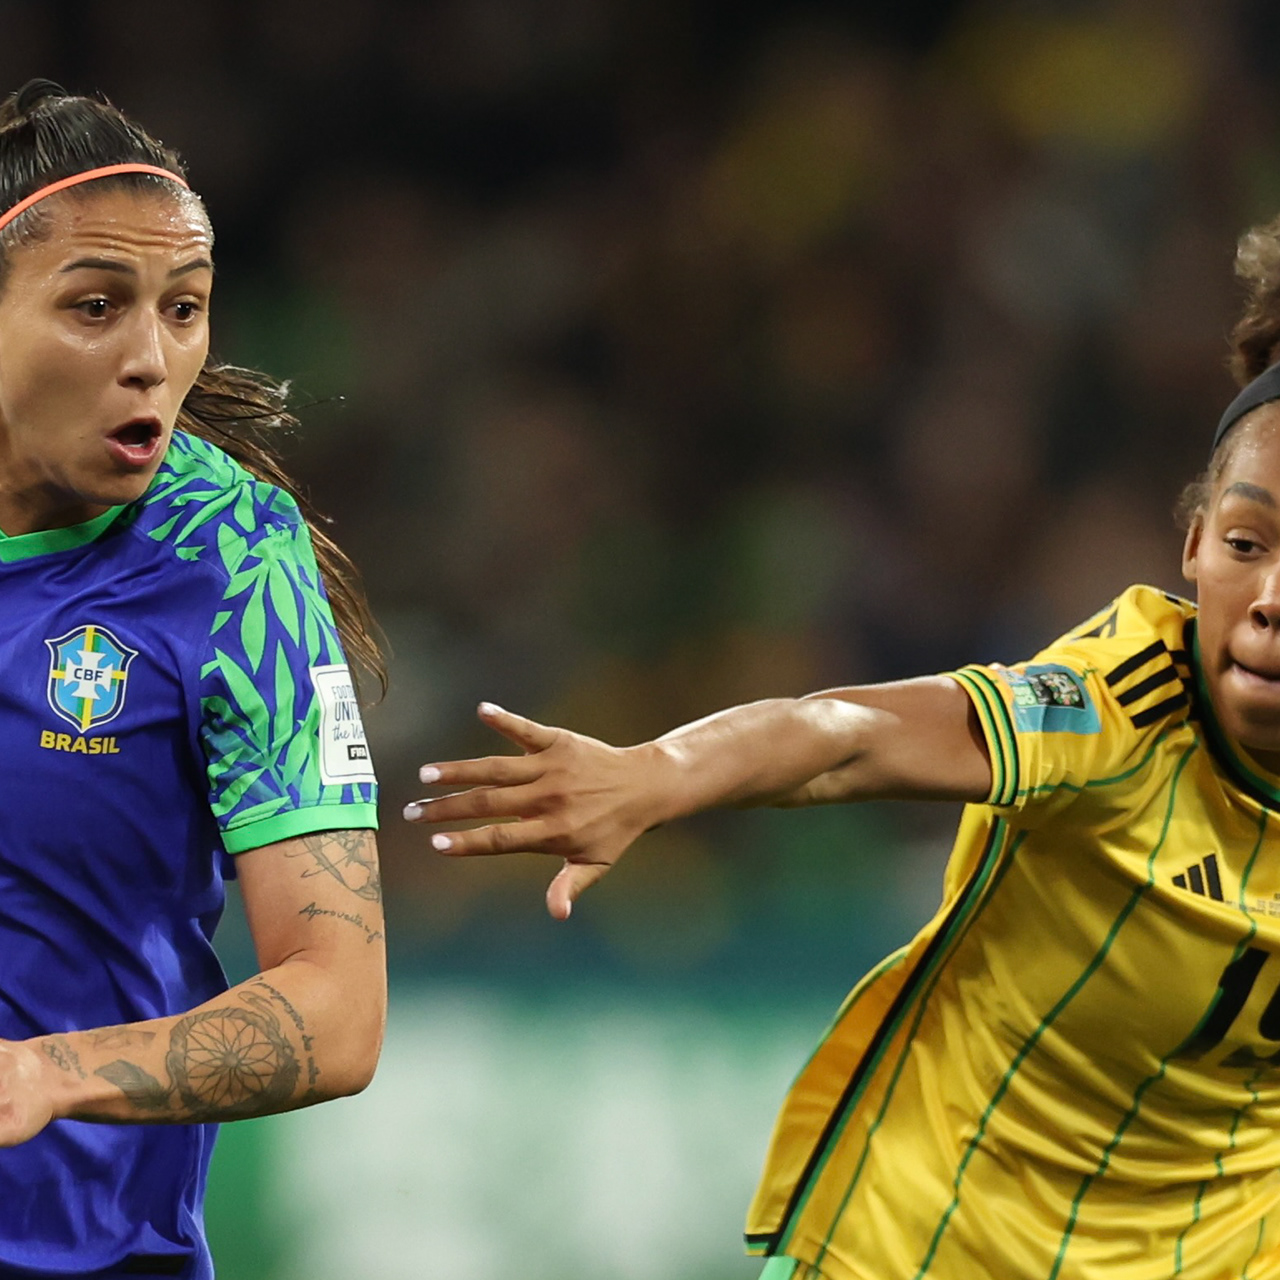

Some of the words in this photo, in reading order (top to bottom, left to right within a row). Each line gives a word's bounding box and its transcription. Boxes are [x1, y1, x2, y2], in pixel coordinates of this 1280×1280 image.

[74, 668, 104, 682] CBF
[40, 730, 120, 754] BRASIL
[350, 746, 367, 758] FIFA
